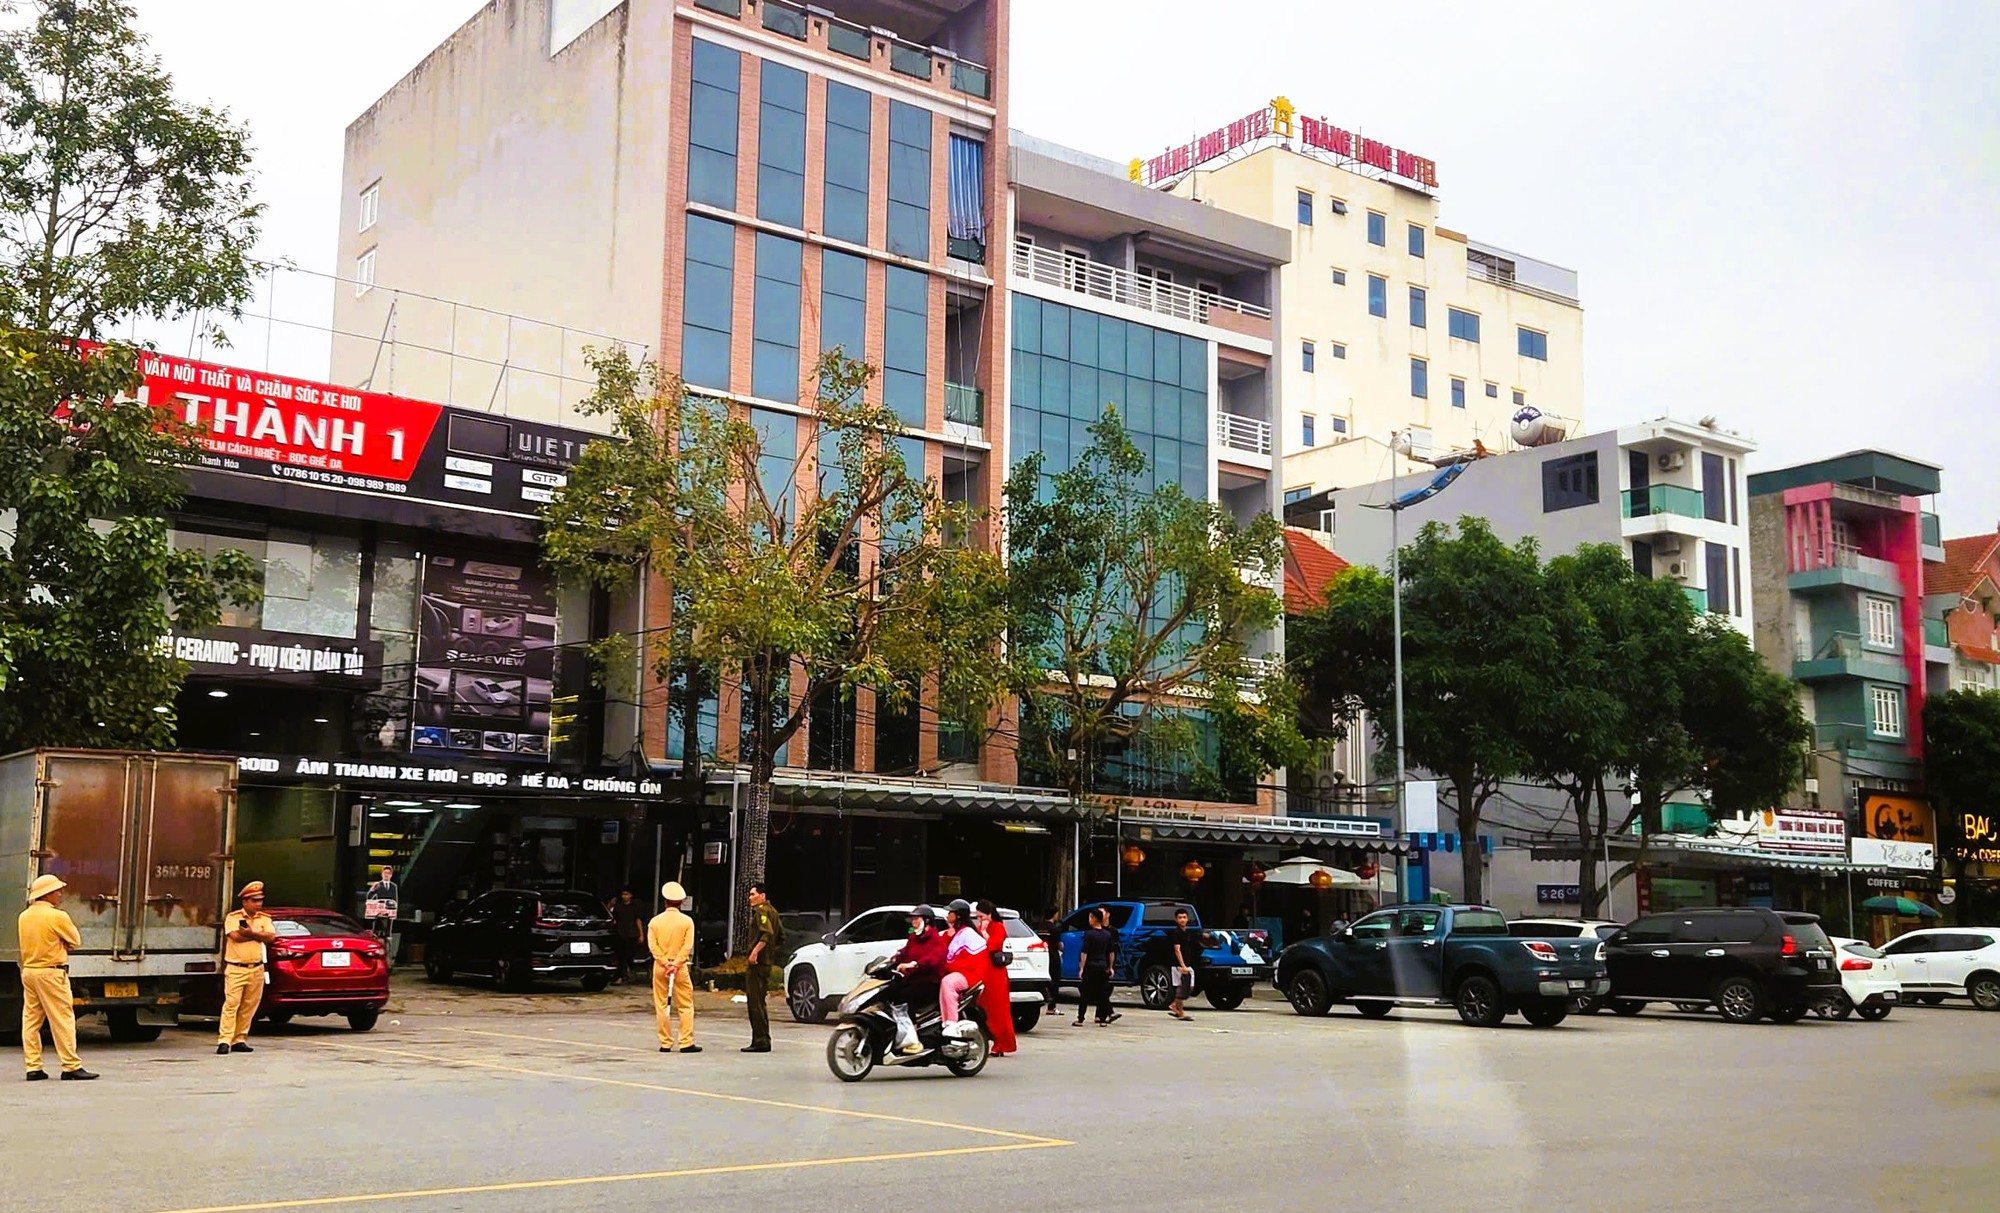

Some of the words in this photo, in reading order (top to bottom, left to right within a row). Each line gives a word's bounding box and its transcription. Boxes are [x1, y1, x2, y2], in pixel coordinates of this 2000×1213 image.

[1148, 146, 1188, 184] THĂNG
[1192, 128, 1224, 167] LONG
[1228, 107, 1269, 150] HOTEL
[1300, 115, 1351, 157] THĂNG
[1355, 134, 1392, 172] LONG
[1397, 149, 1439, 188] HOTEL
[144, 356, 169, 378] VẤN
[173, 363, 195, 385] NỘI
[200, 367, 232, 388] THẤT
[236, 371, 252, 392] VÀ
[256, 379, 292, 400] CHĂM
[295, 384, 319, 404] SÓC
[322, 390, 338, 406] XE
[341, 394, 361, 412] HƠI
[175, 391, 366, 455] THÀNH
[387, 429, 405, 461] 1
[224, 458, 239, 469] Hóa
[227, 442, 252, 455] CÁCH
[330, 458, 342, 469] DA
[283, 467, 307, 479] 0786
[384, 482, 407, 493] 1989
[531, 472, 558, 484] GTR
[176, 636, 239, 664] CERAMIC
[250, 643, 278, 671] PHỤ
[279, 643, 311, 672] KIỆN
[313, 643, 340, 673] BÁN
[344, 646, 363, 676] TẢI
[296, 758, 329, 775] ÂM
[334, 762, 396, 779] THANH
[399, 767, 424, 781] XE
[428, 768, 457, 783] HƠI
[472, 771, 507, 788] BỌC
[546, 776, 569, 790] DA
[583, 776, 636, 794] CHỐNG
[1550, 888, 1565, 900] 26
[1866, 877, 1900, 889] COFFEE
